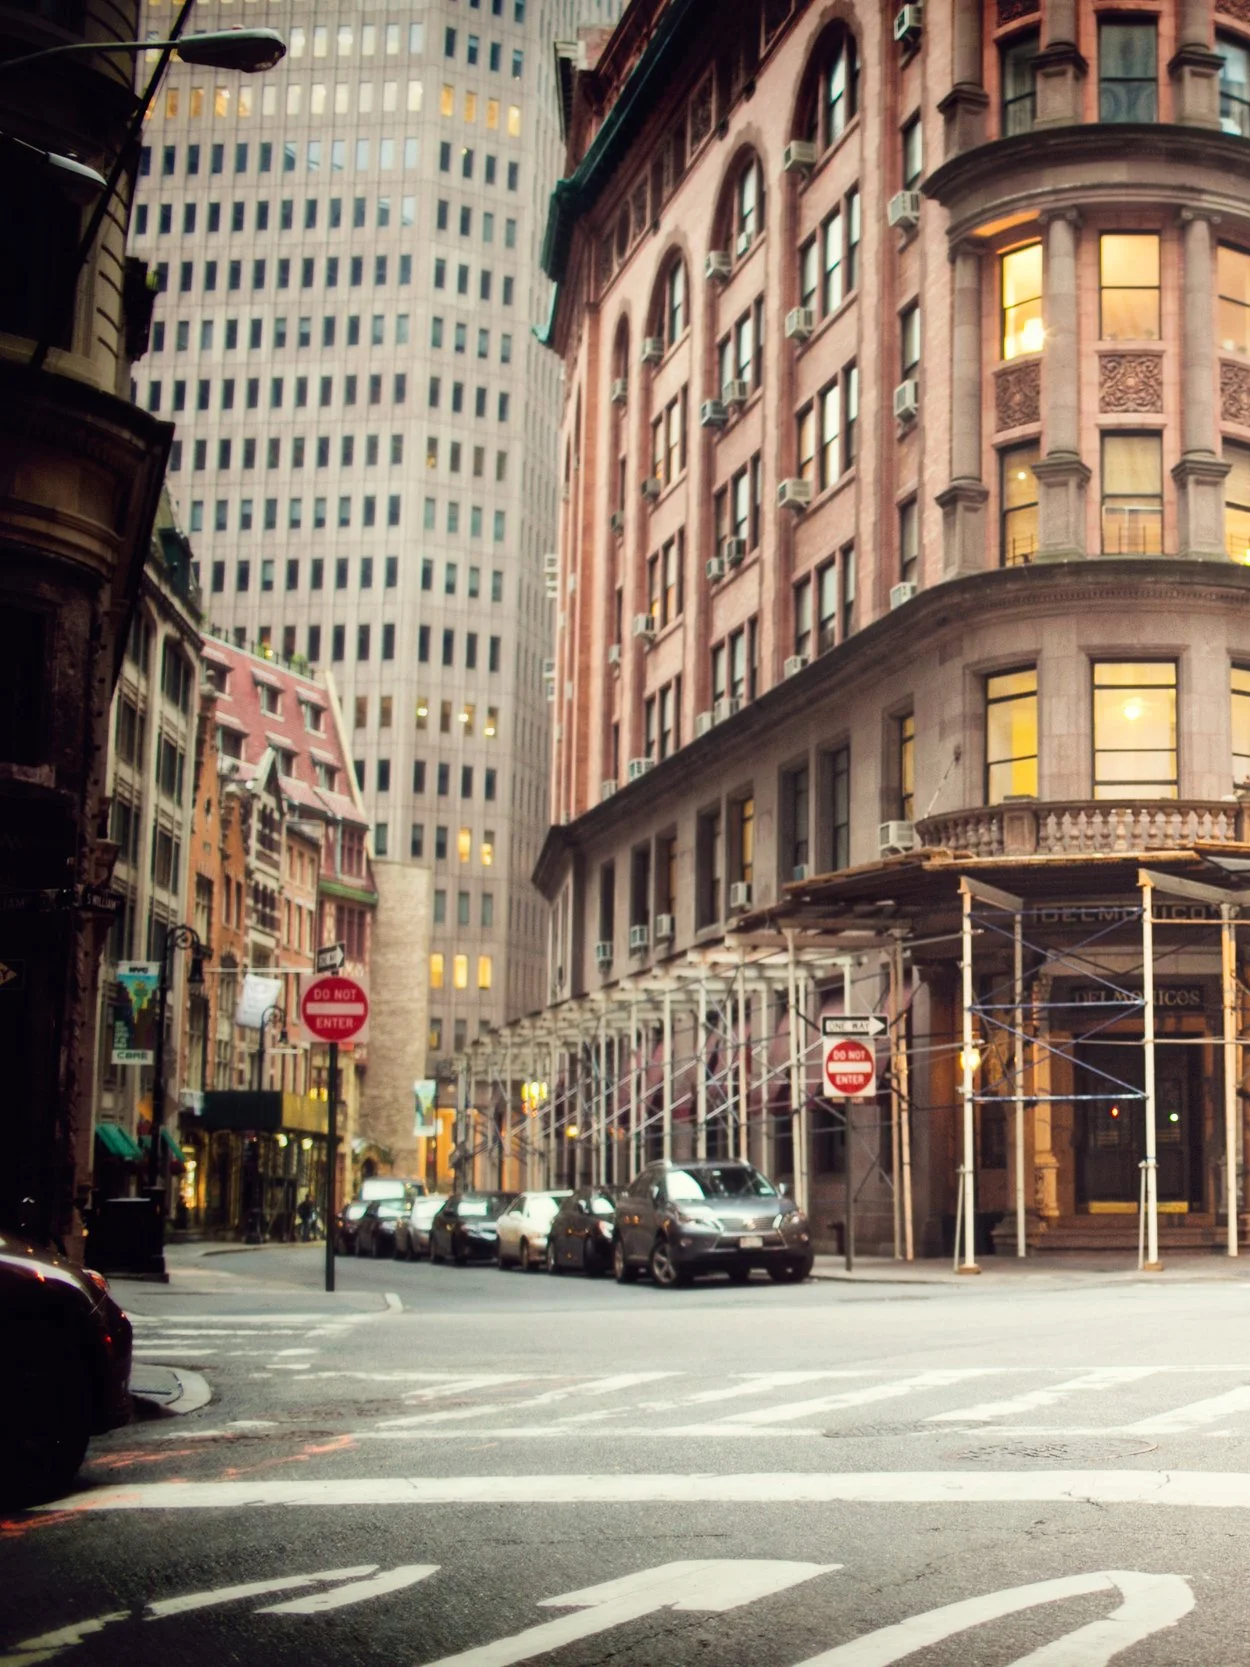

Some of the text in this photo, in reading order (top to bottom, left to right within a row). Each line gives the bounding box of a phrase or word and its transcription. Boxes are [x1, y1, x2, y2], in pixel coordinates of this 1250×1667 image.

[313, 989, 357, 1000] DO NOT
[316, 1018, 354, 1029] ENTER
[829, 1022, 870, 1031] ONE WAY
[833, 1050, 866, 1060] DO NOT
[836, 1075, 865, 1085] ENTER
